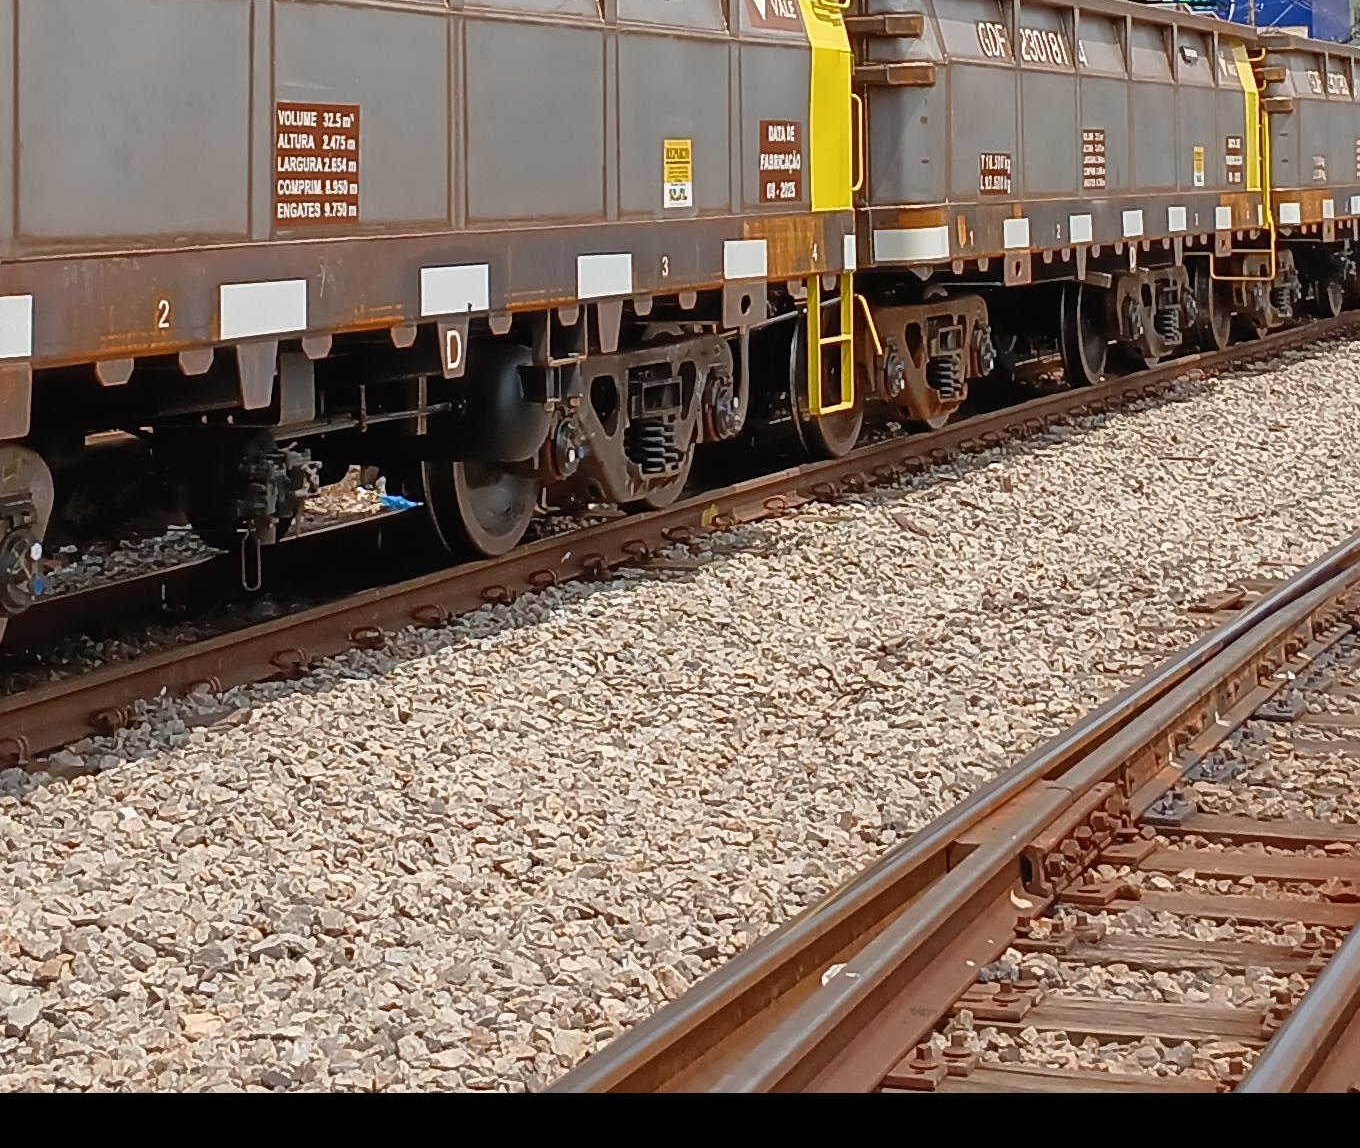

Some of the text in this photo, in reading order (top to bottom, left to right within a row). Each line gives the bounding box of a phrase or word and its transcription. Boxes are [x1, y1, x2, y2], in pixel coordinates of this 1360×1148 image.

[978, 23, 1006, 57] GDF
[277, 110, 317, 127] VOLUME
[323, 112, 341, 127] 32.5
[277, 133, 315, 149] ALTURA
[322, 135, 346, 150] 2.475
[768, 125, 785, 142] DATA
[277, 156, 322, 172] LARGURA
[760, 150, 801, 174] FABRICAÇÃO
[277, 202, 321, 218] ENGATES
[662, 255, 670, 277] 3
[157, 299, 171, 329] 2
[446, 329, 462, 370] D
